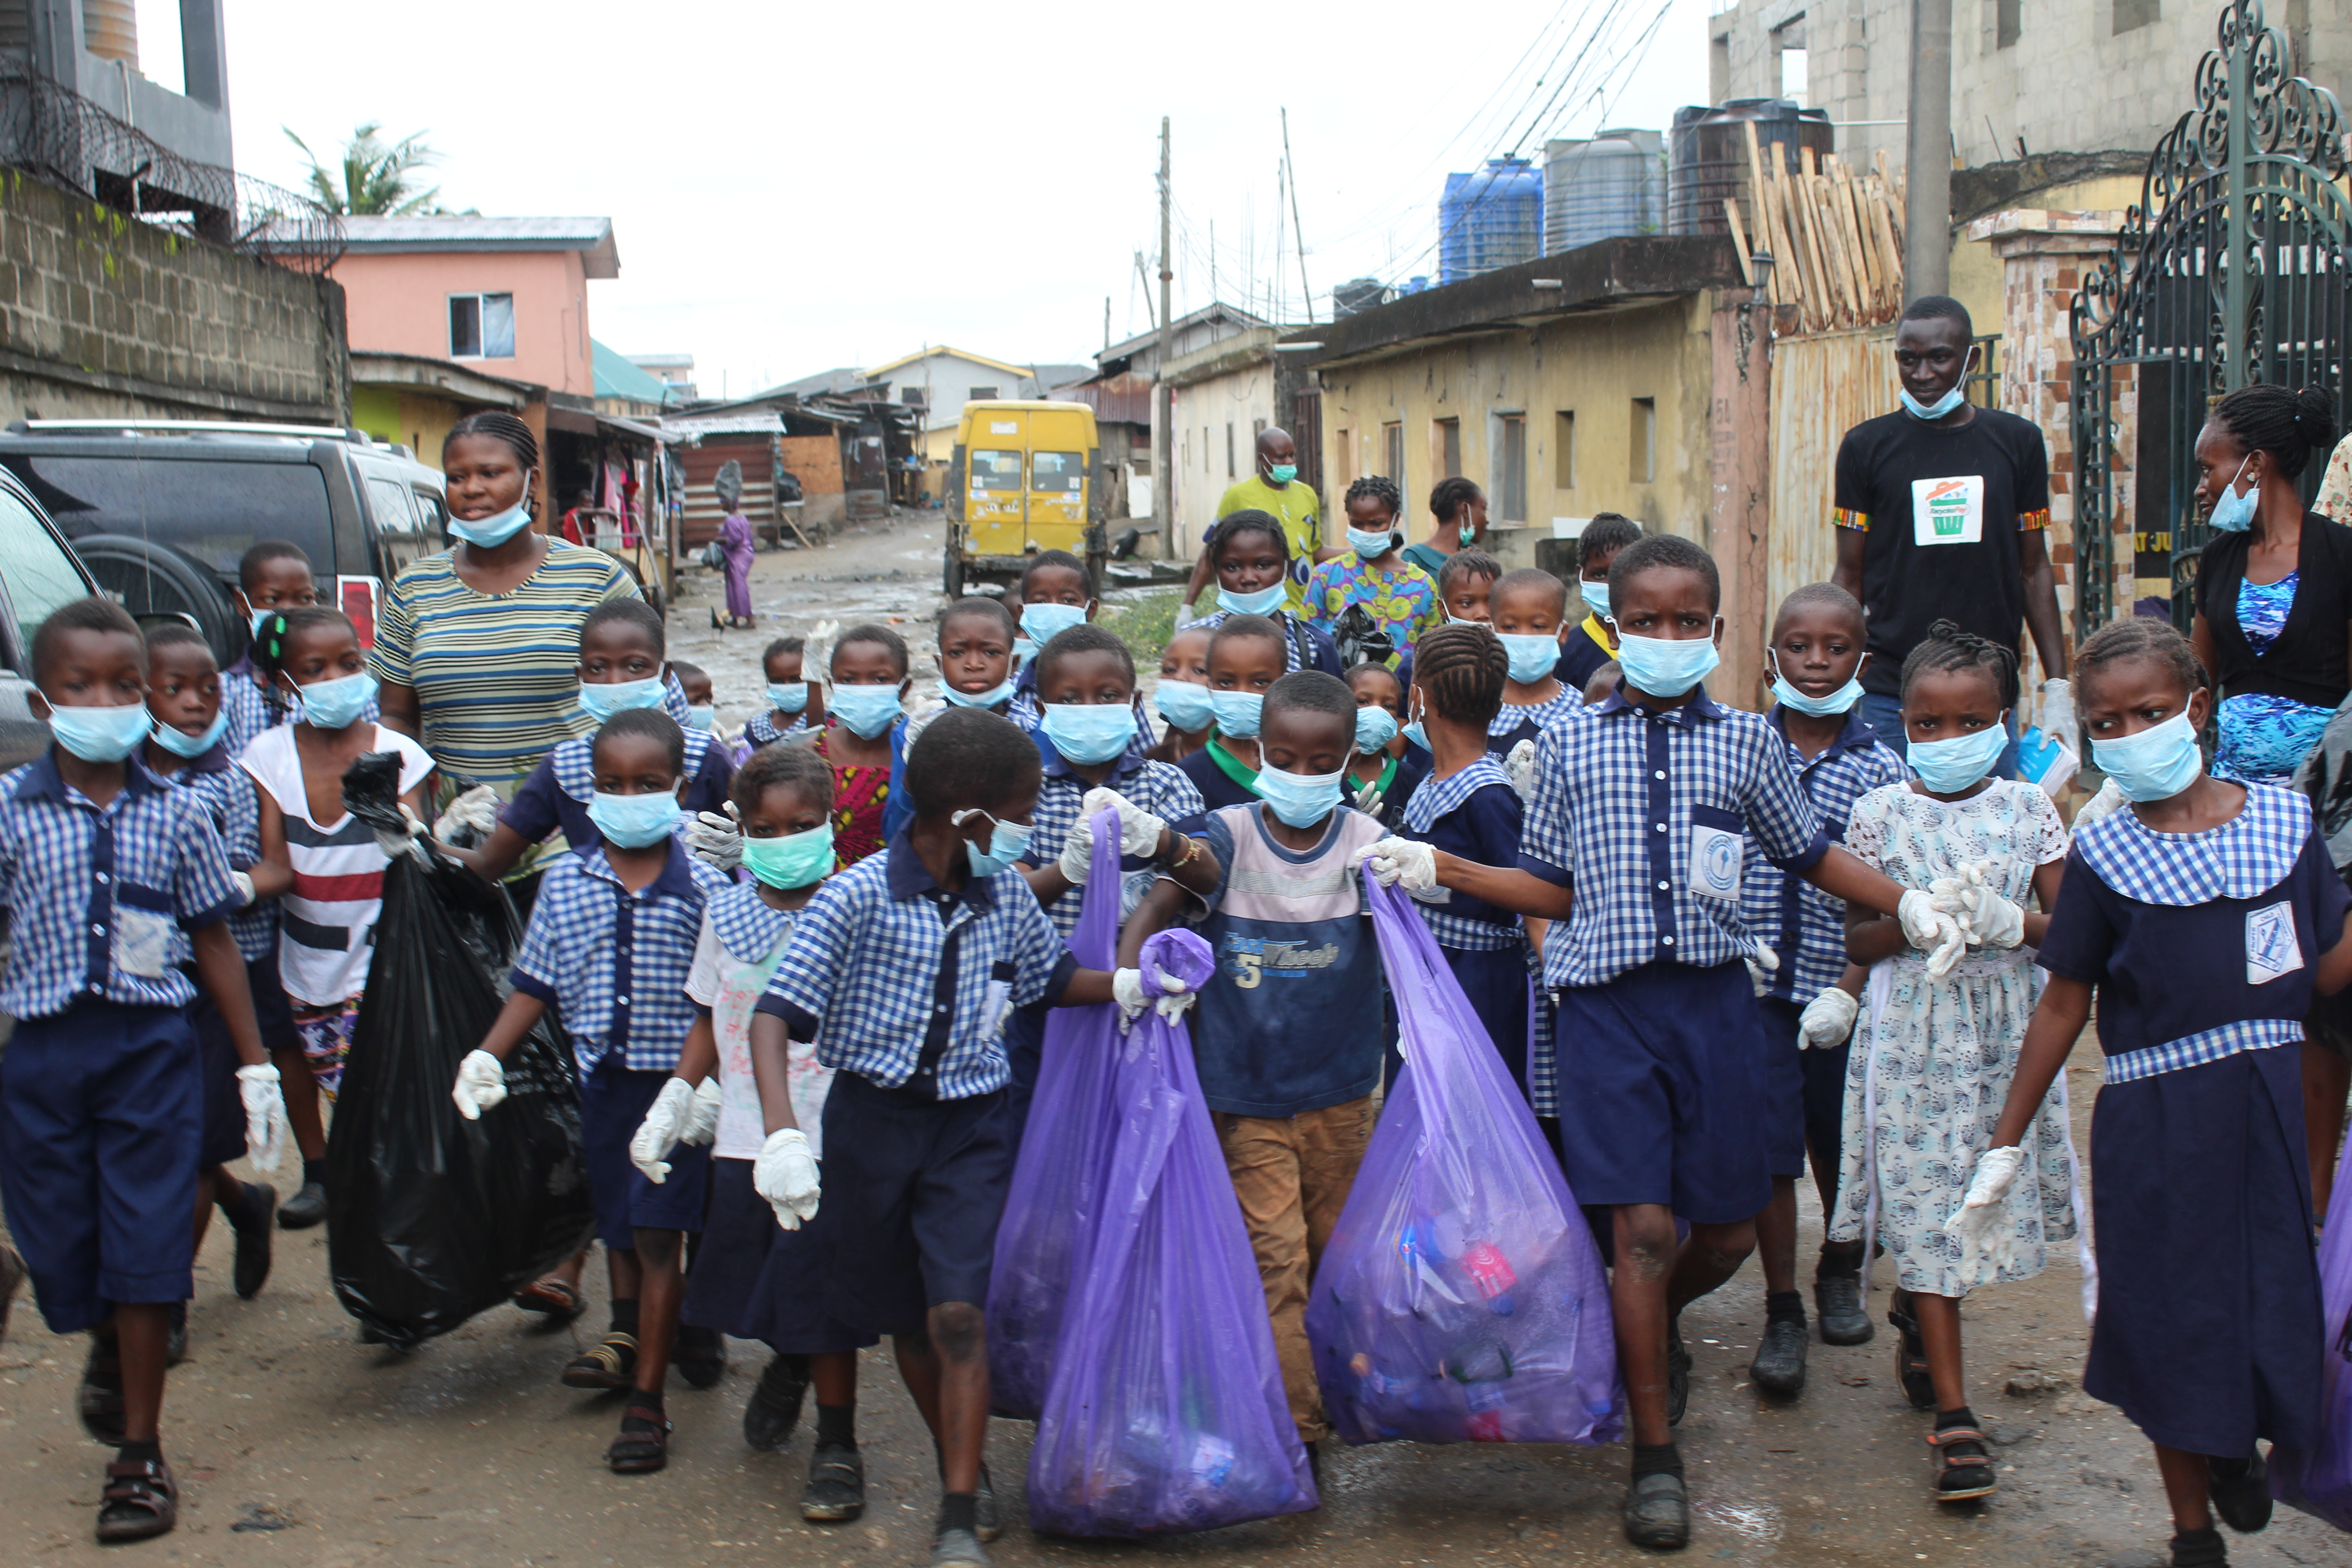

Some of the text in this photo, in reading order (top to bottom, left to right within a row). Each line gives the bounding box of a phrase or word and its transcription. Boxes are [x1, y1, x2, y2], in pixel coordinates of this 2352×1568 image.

[1216, 931, 1339, 968] Fast Wheels
[1235, 954, 1262, 989] 5
